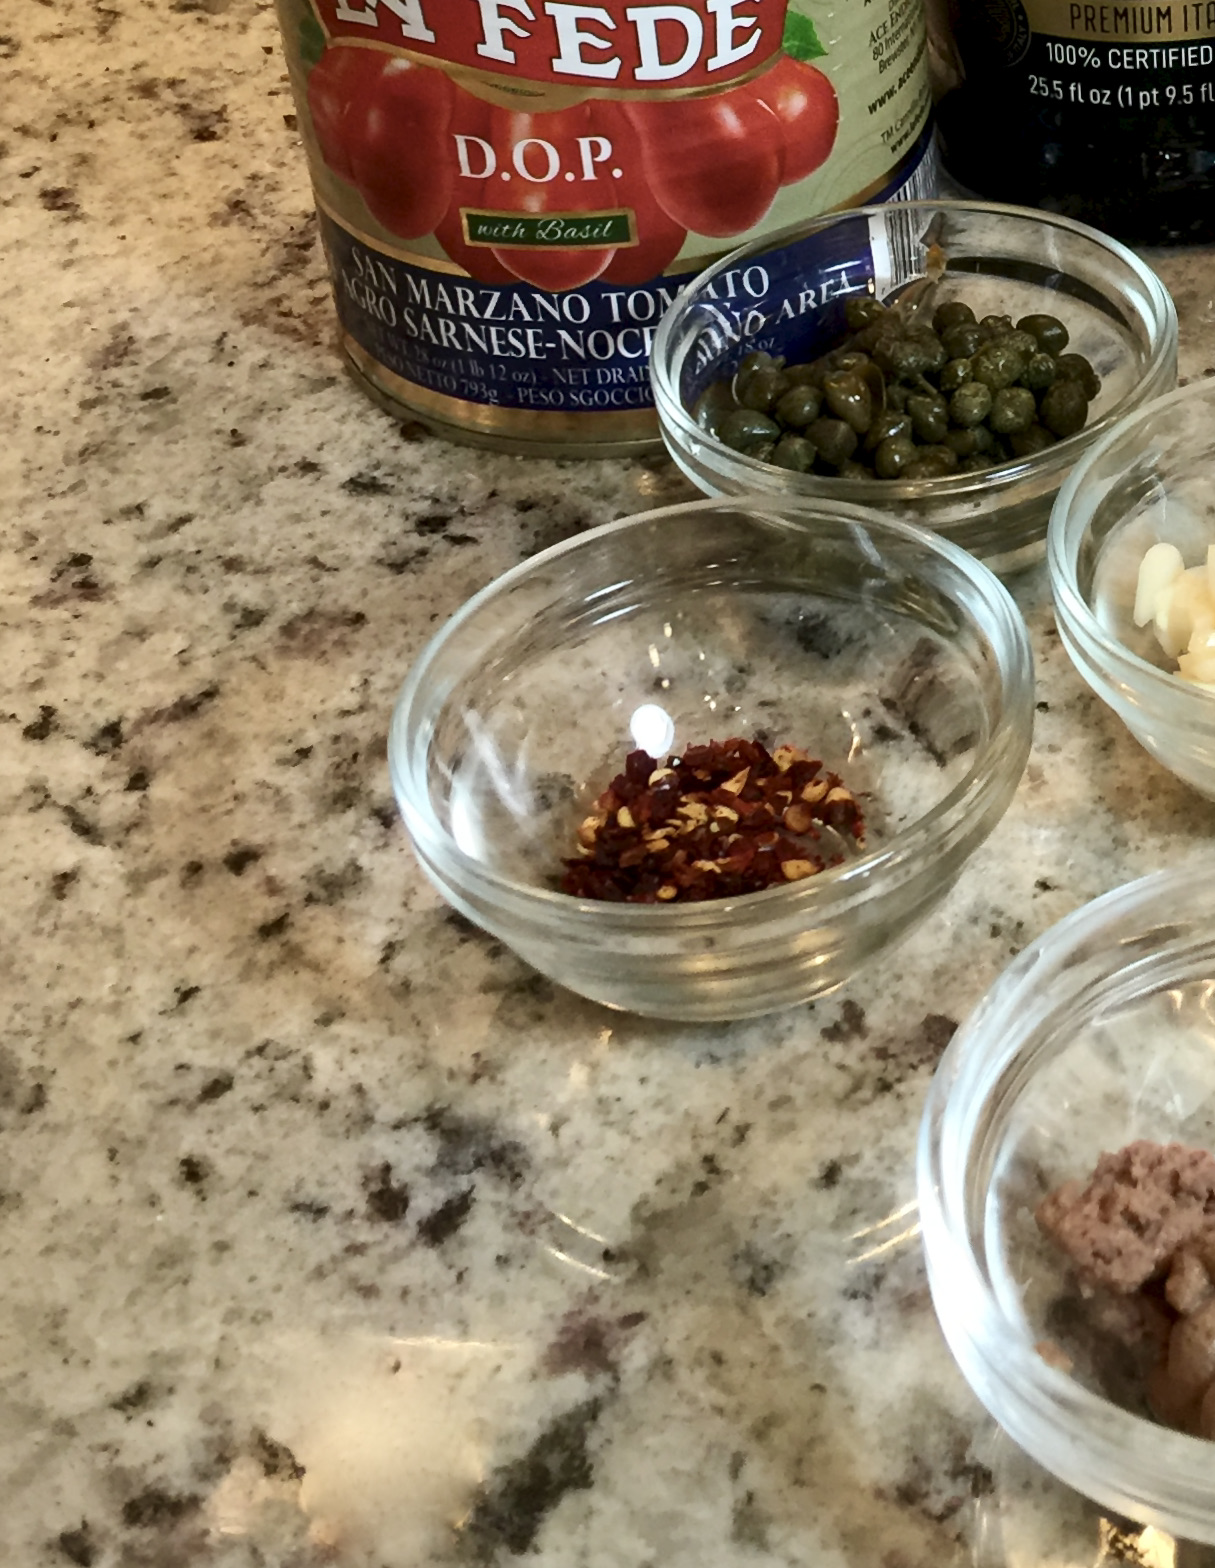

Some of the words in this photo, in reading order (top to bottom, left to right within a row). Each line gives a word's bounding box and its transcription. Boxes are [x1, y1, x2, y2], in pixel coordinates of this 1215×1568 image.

[1069, 3, 1173, 34] PREMIUM
[868, 20, 888, 47] ACE
[872, 41, 884, 61] 80
[1046, 42, 1101, 68] 100%
[1108, 45, 1213, 70] CERTIFIED
[1028, 74, 1064, 100] 25.5
[1069, 81, 1085, 104] fl
[1089, 88, 1112, 106] oz
[1117, 84, 1133, 109] (1
[1139, 87, 1160, 110] pt
[1165, 84, 1194, 106] 9.5
[1200, 81, 1215, 104] fl
[451, 133, 624, 183] D.O.P.
[477, 222, 527, 239] with
[535, 217, 615, 242] Basil
[340, 267, 398, 328] AGRO
[774, 269, 852, 325] AREA
[351, 246, 398, 296] SAN
[404, 273, 591, 324] MARZANO
[488, 363, 507, 383] 12
[551, 367, 591, 386] NET
[460, 378, 499, 405] 793g
[516, 386, 565, 406] PESO
